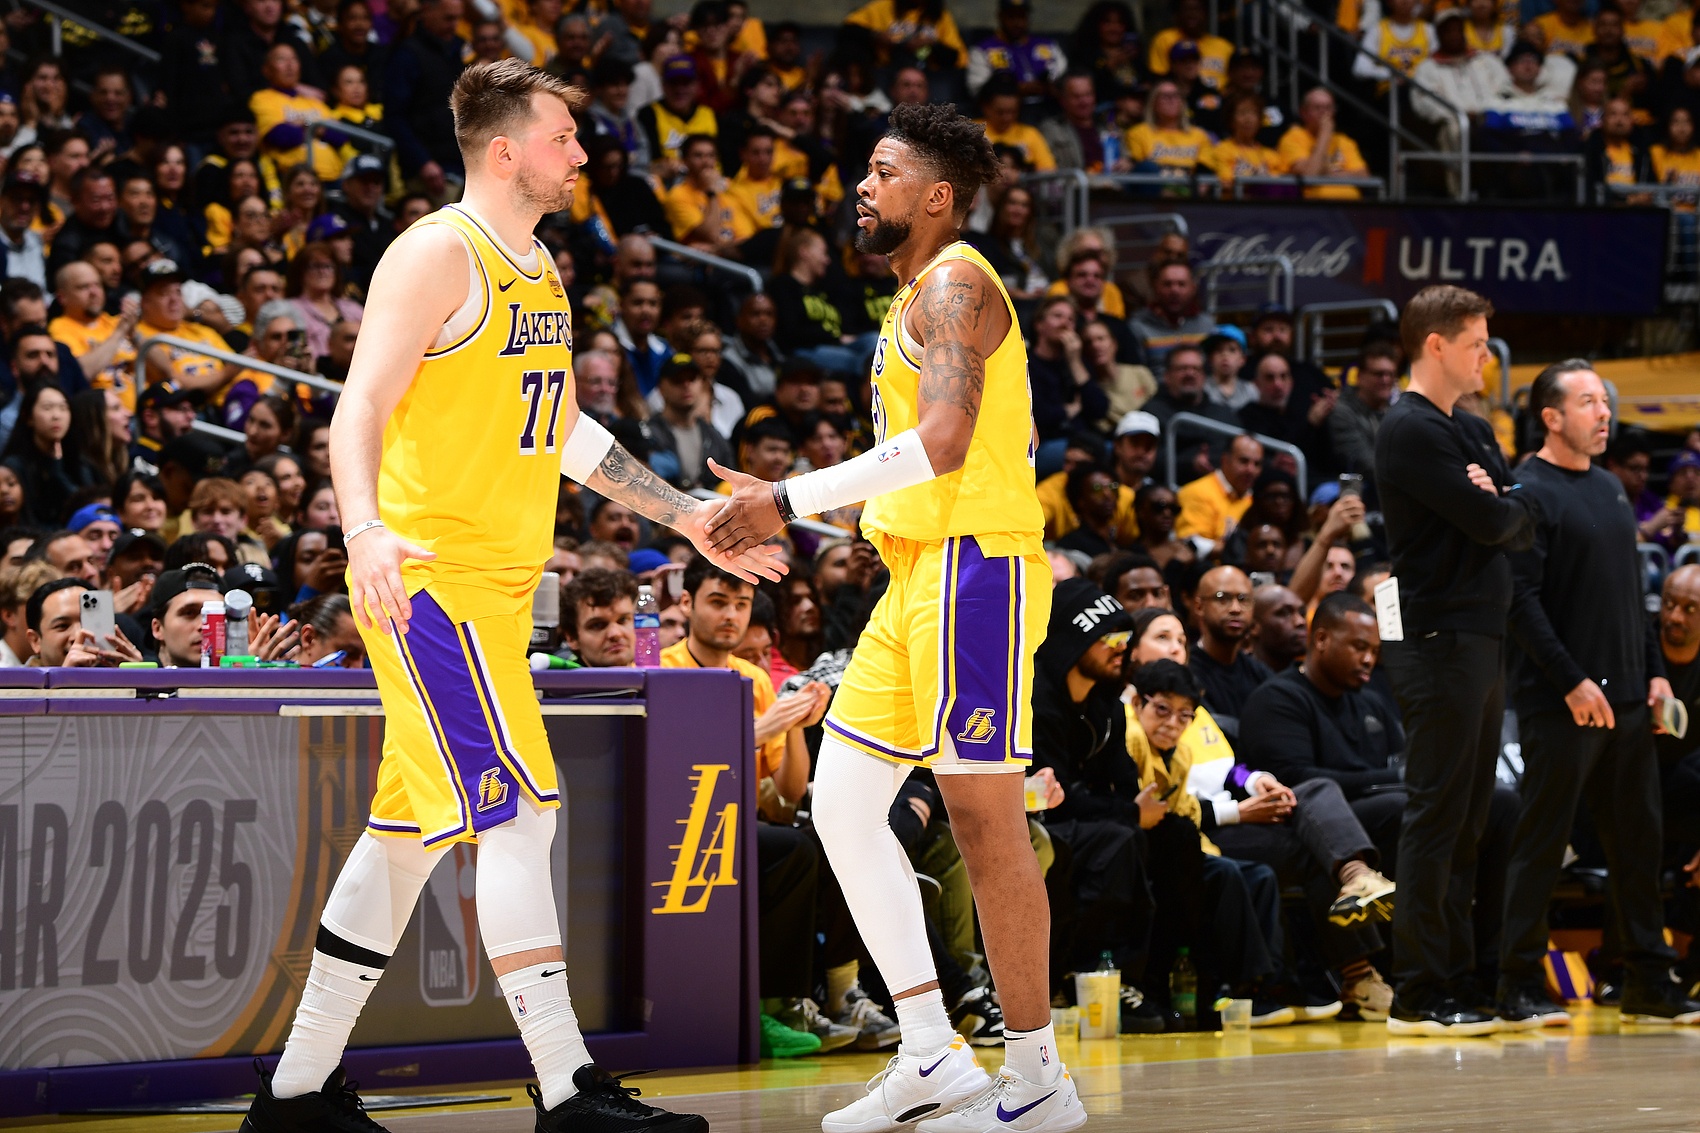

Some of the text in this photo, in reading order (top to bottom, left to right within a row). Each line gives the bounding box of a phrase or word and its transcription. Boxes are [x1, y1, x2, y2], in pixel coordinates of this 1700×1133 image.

[1400, 236, 1567, 281] ULTRA
[497, 302, 573, 357] LAKERS
[519, 368, 567, 456] 77
[82, 799, 258, 985] 2025
[429, 950, 457, 988] NBA
